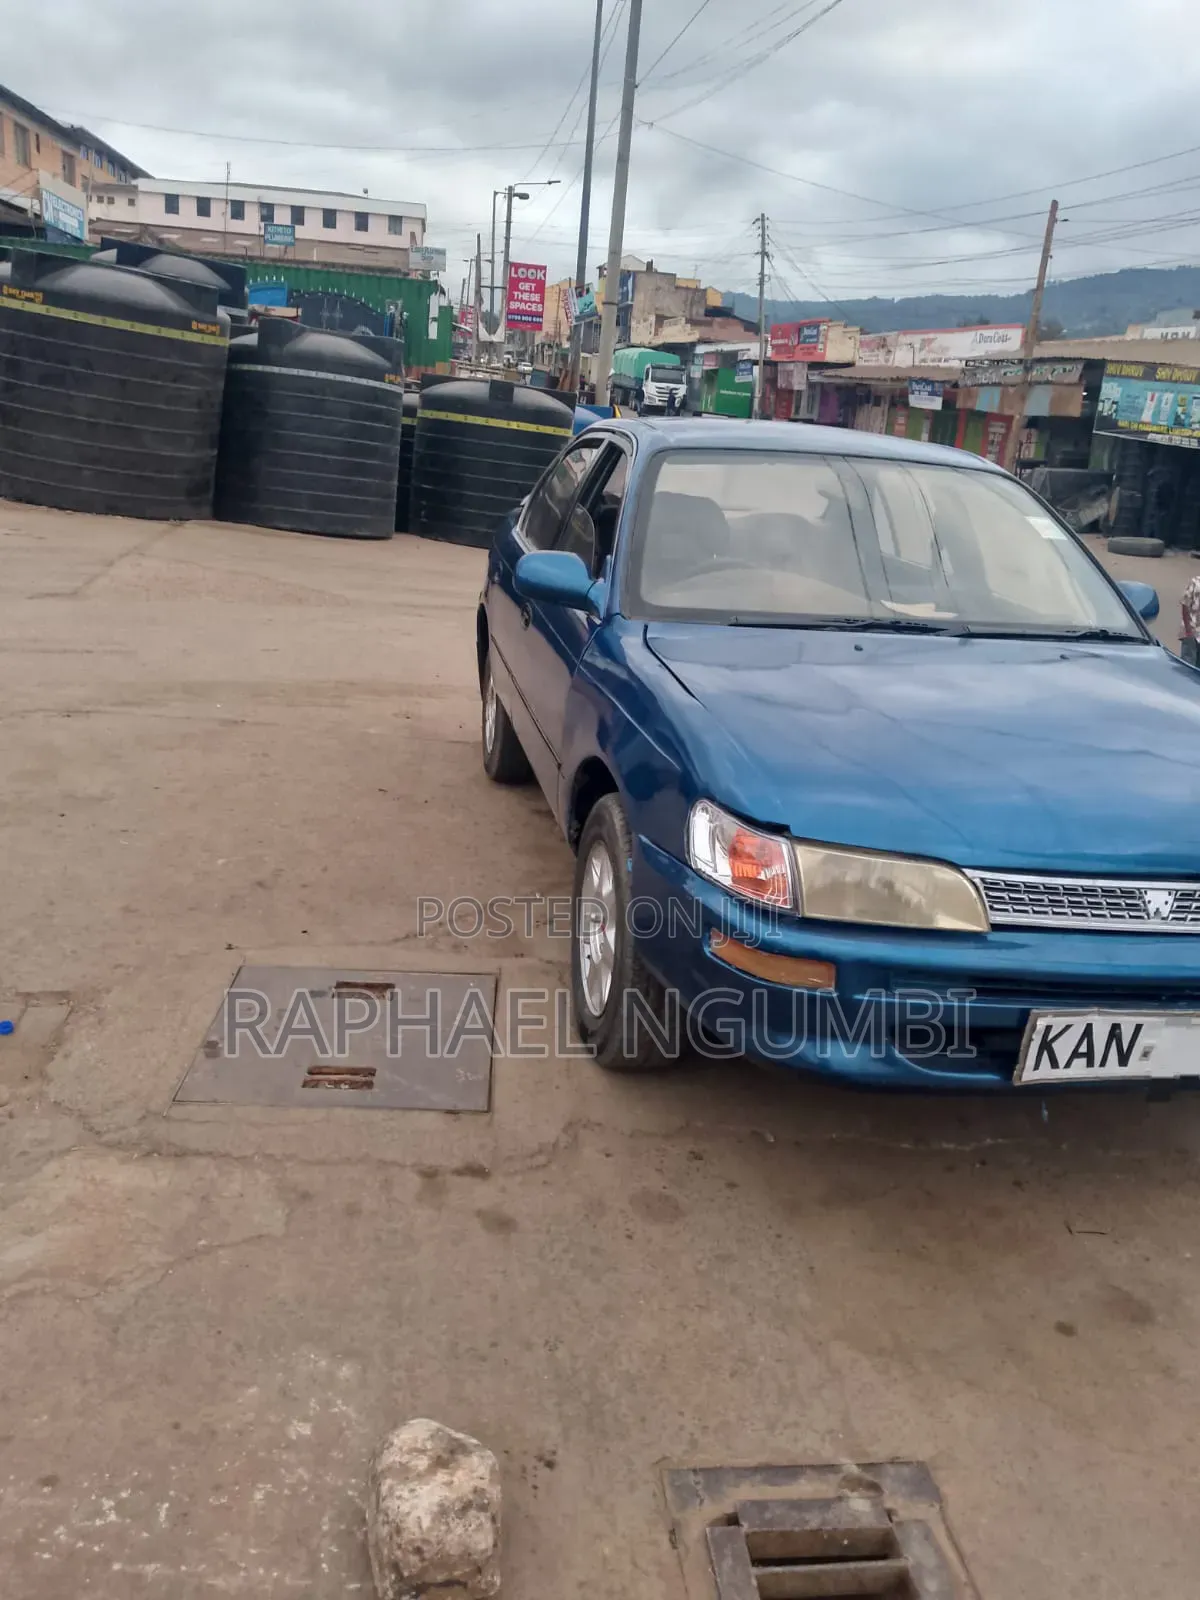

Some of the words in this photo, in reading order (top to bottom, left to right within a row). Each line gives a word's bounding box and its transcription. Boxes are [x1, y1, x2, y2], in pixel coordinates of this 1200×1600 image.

[510, 266, 546, 280] LOOK
[518, 282, 537, 292] GET
[513, 291, 541, 302] THESE
[509, 301, 543, 312] SPACES
[1032, 1022, 1145, 1072] KAN
